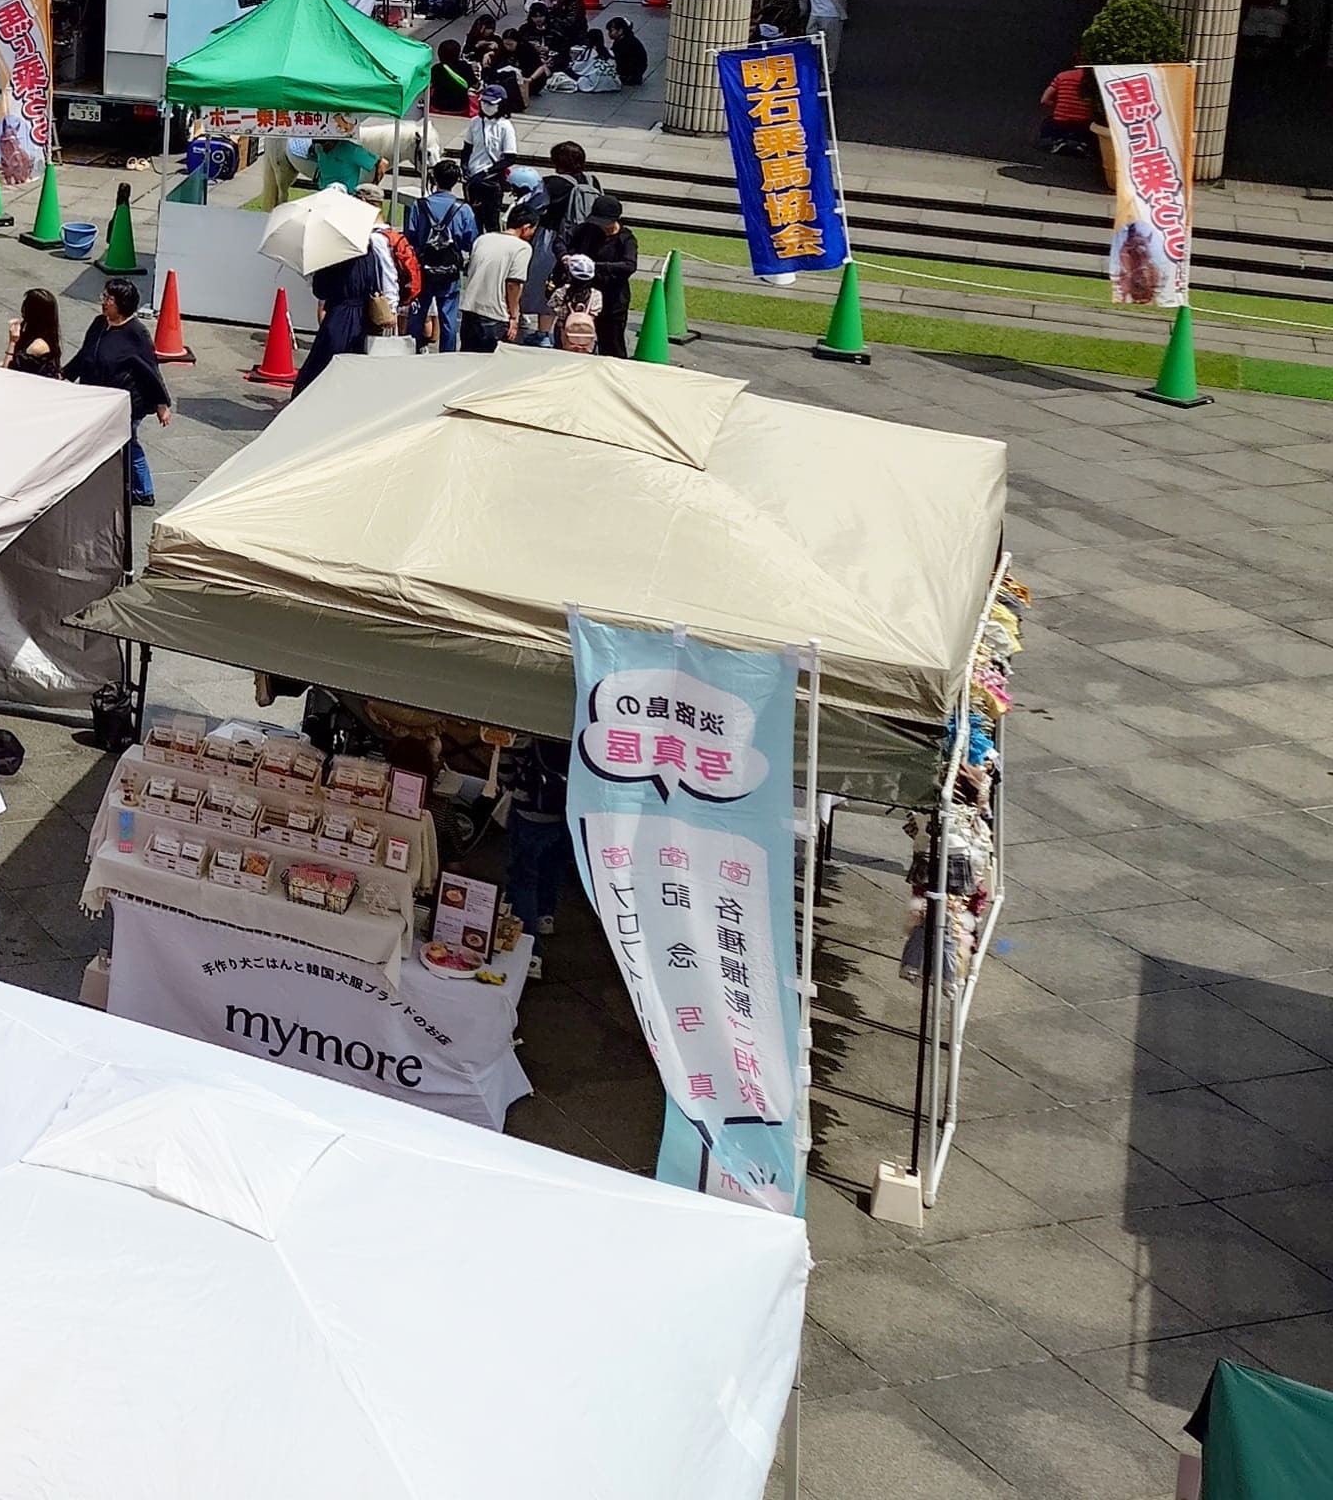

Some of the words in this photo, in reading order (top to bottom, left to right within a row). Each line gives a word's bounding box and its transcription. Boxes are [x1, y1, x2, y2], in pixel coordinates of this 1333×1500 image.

[740, 52, 826, 259] 明石乗馬協会
[201, 955, 456, 1047] 手作り犬ごはんと韓国犬服ブランドのお店
[224, 1002, 424, 1089] mymore
